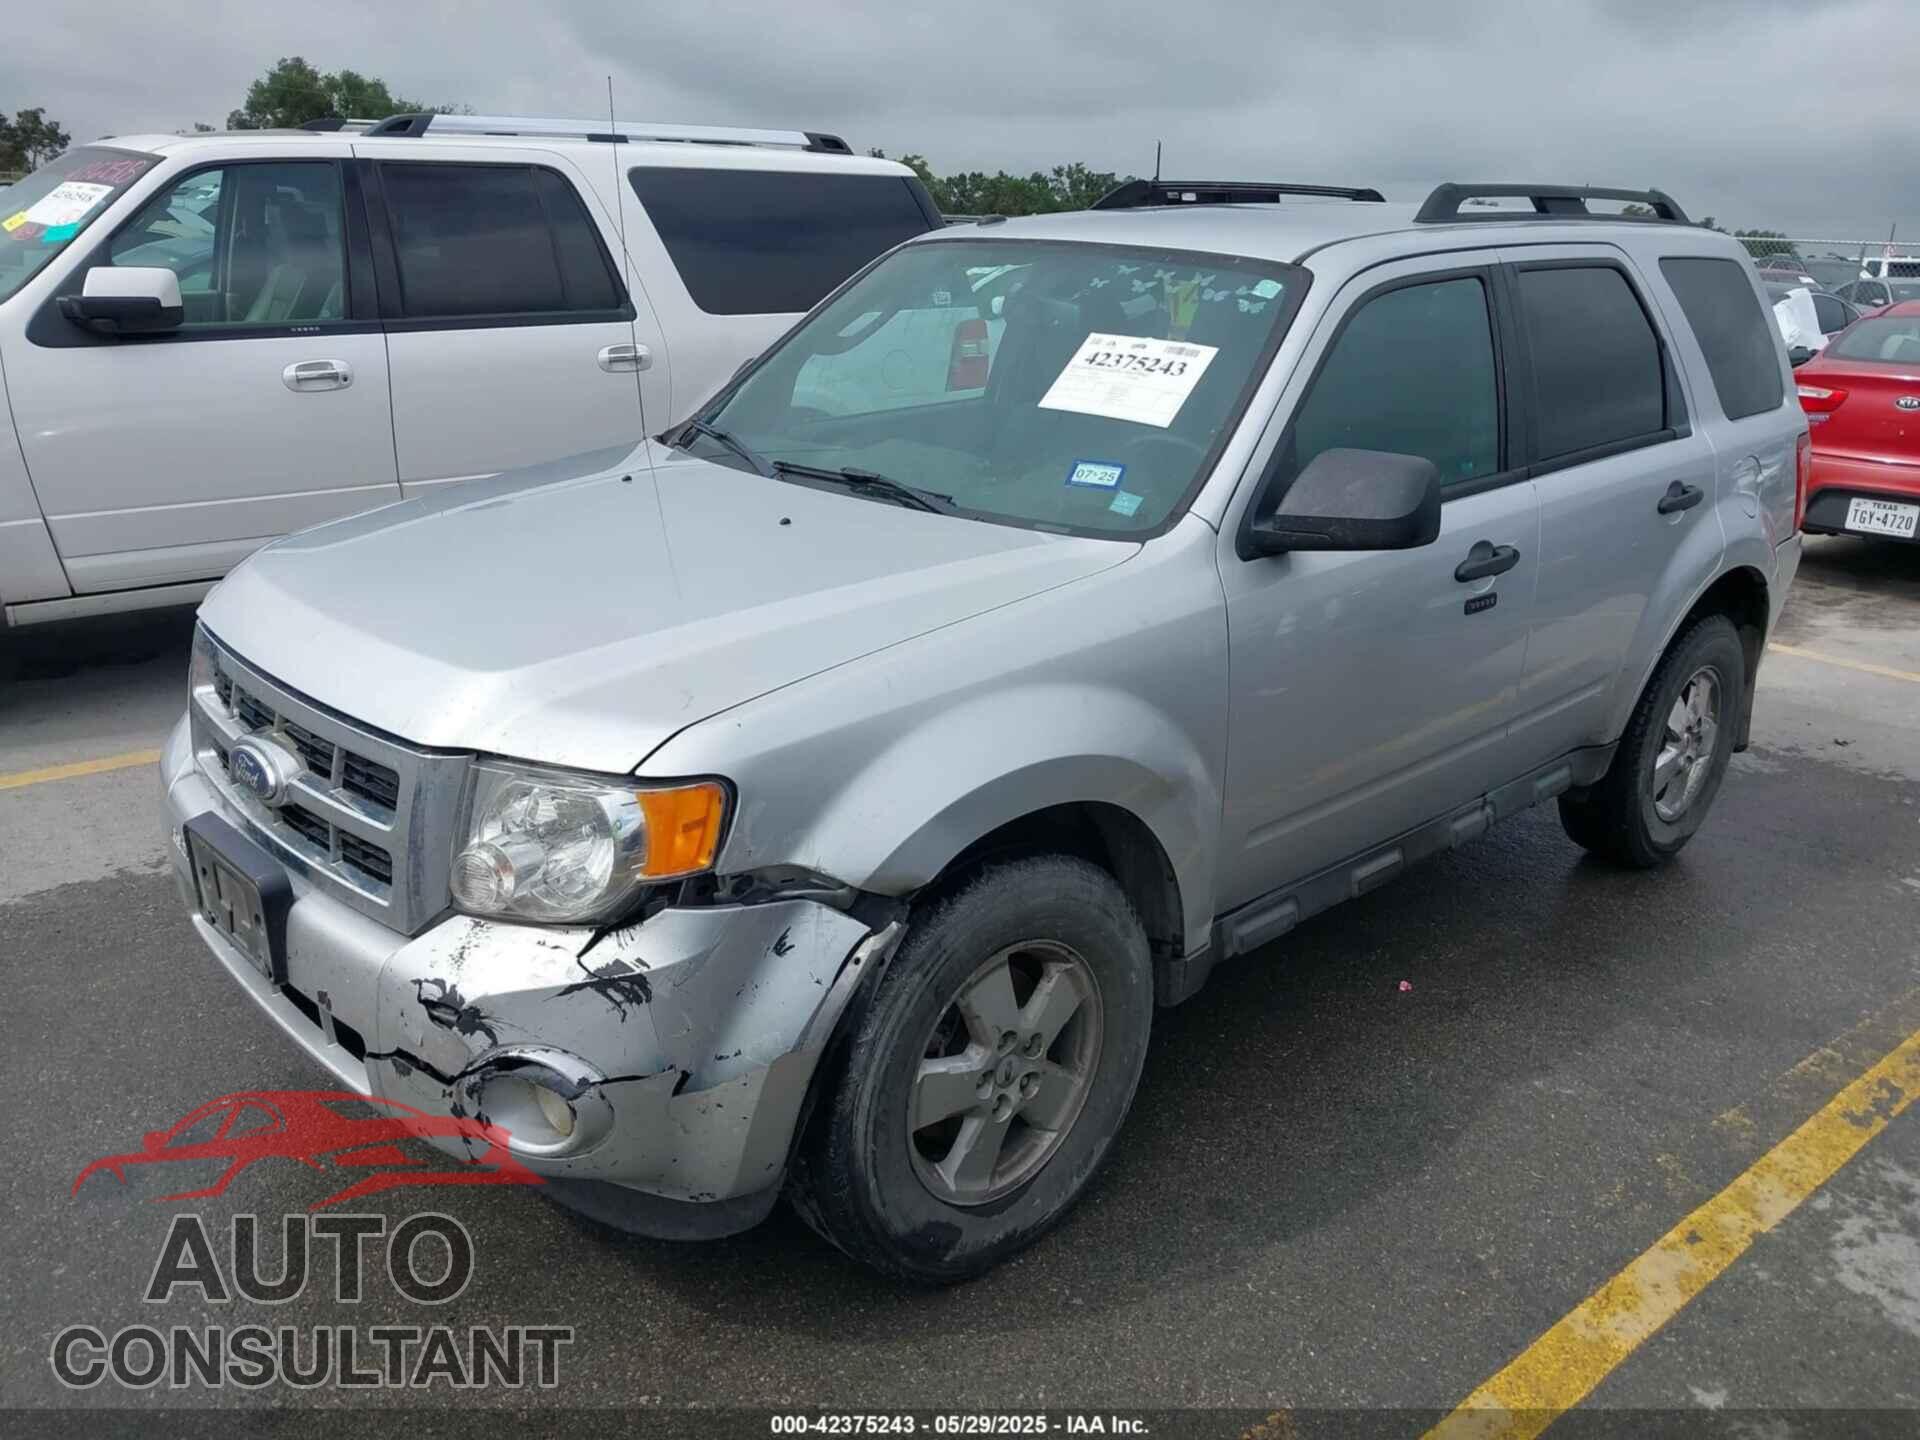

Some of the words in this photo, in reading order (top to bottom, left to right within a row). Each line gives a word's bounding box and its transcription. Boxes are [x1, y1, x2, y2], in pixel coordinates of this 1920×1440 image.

[1085, 351, 1187, 377] 42375243
[1899, 399, 1919, 408] KIA
[1076, 469, 1093, 480] 07
[1098, 471, 1117, 482] 25
[1872, 502, 1898, 511] TEXAS
[1852, 508, 1913, 530] TGY-4720
